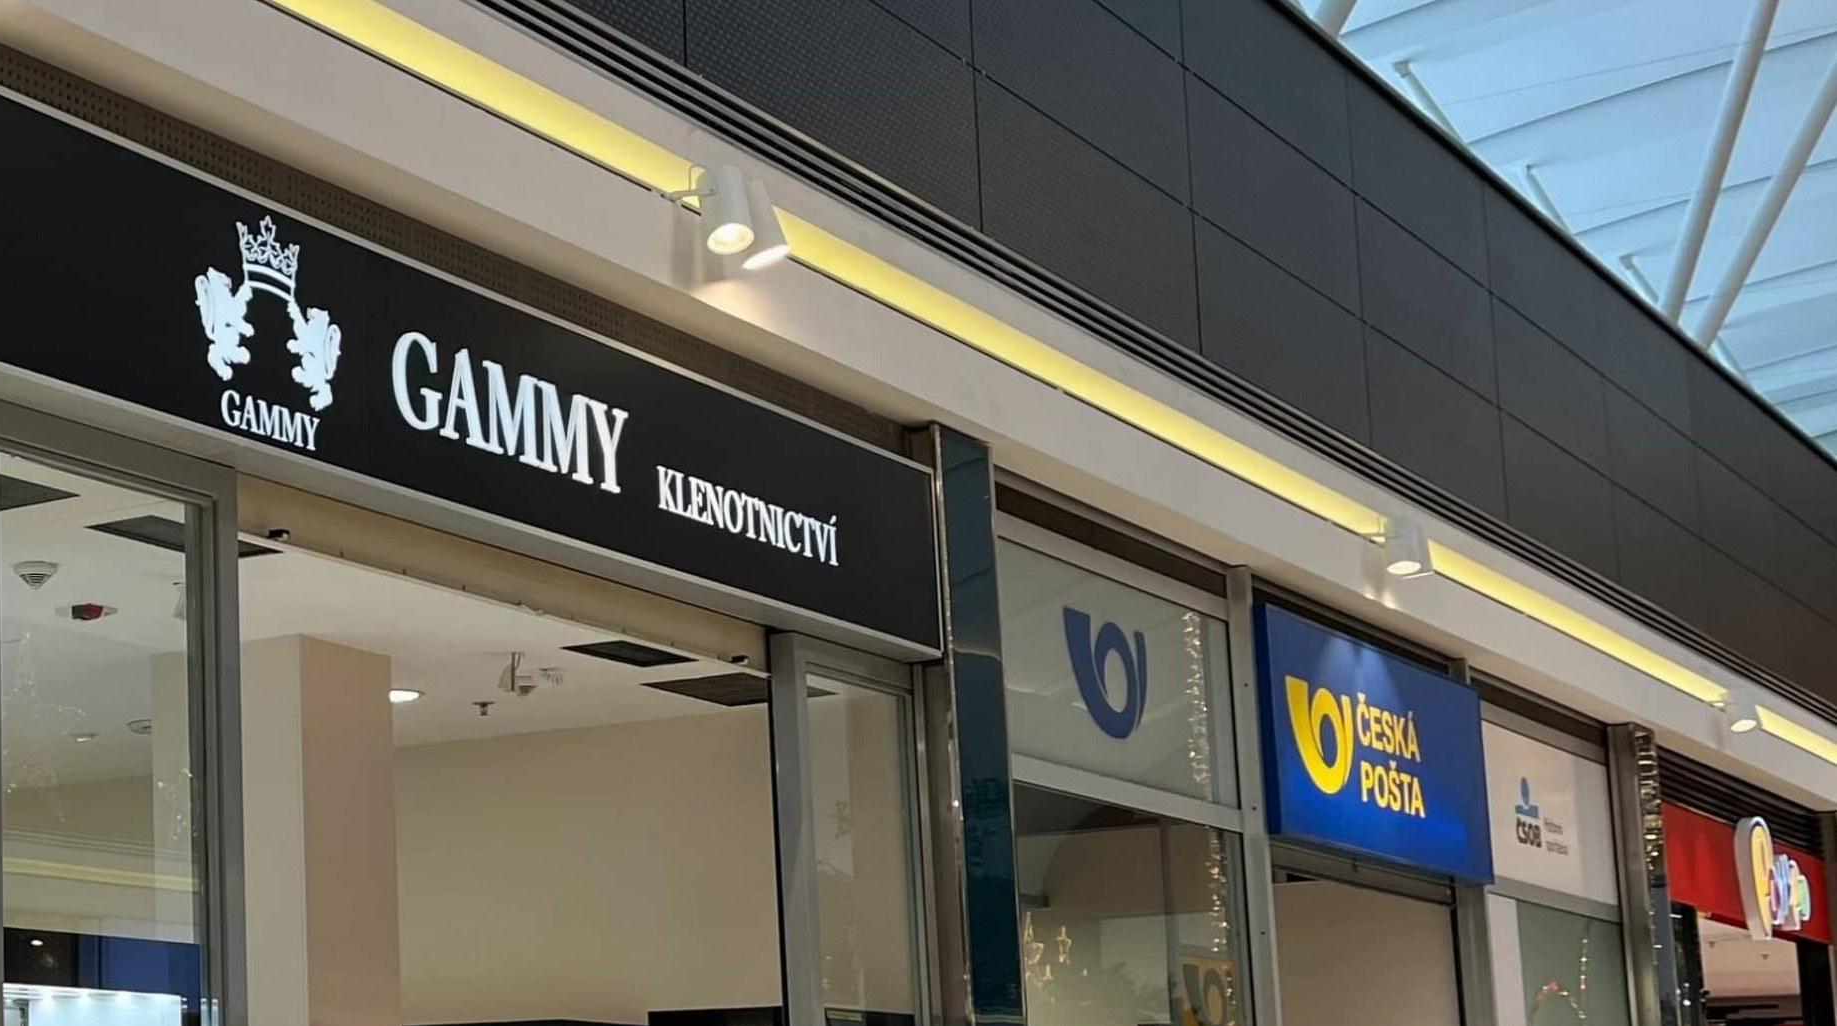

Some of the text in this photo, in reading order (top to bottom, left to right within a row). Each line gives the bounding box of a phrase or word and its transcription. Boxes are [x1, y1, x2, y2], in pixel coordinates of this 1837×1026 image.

[221, 389, 320, 452] GAMMY
[392, 331, 839, 567] GAMMY KLENOTNICTVÍ
[1357, 692, 1421, 762] ČESKÁ
[1361, 760, 1426, 818] POŠTA
